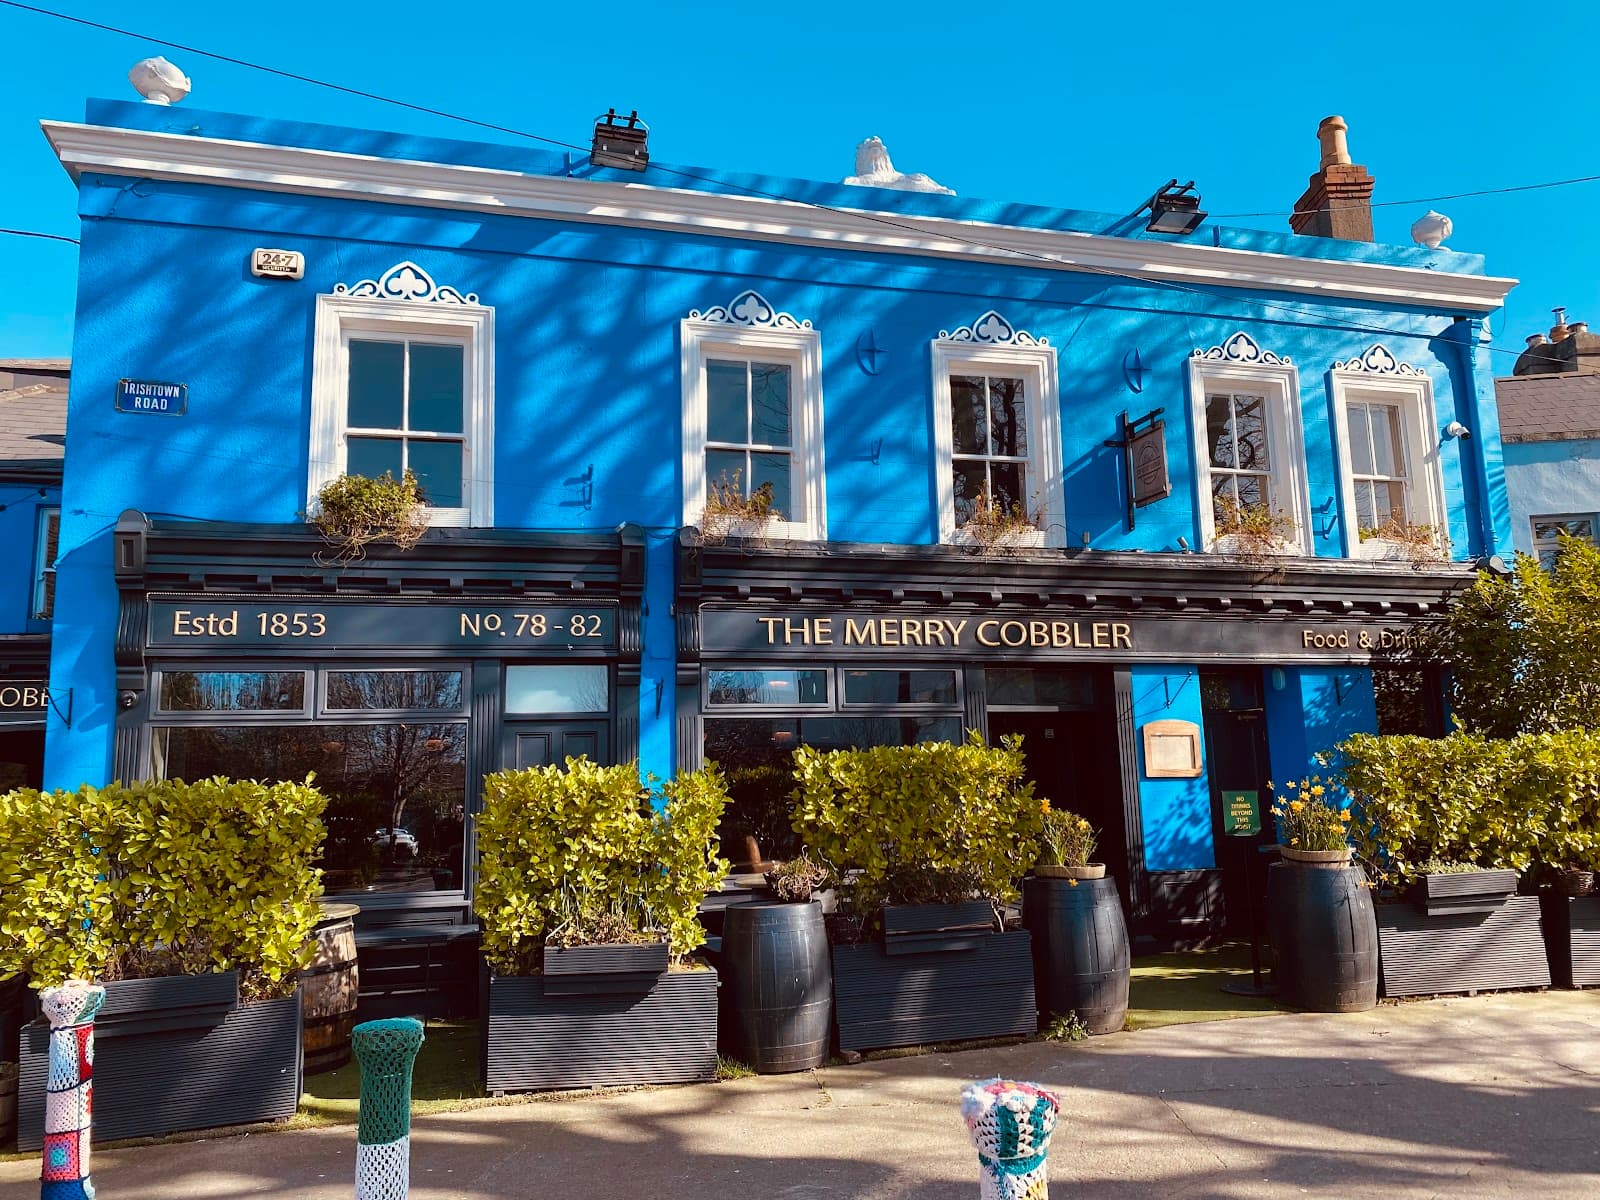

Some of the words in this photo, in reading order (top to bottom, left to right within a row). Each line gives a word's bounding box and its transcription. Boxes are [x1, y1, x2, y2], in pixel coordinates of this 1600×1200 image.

[124, 382, 180, 398] IRISHTOWN
[134, 396, 168, 410] ROAD
[173, 610, 238, 636] Estd
[256, 612, 326, 637] 1853
[513, 614, 547, 637] 78
[570, 614, 602, 637] 82
[758, 617, 834, 645] THE
[844, 618, 968, 647] MERRY
[976, 620, 1133, 649] COBBLER
[1303, 629, 1349, 649] Food
[1358, 630, 1373, 649] &
